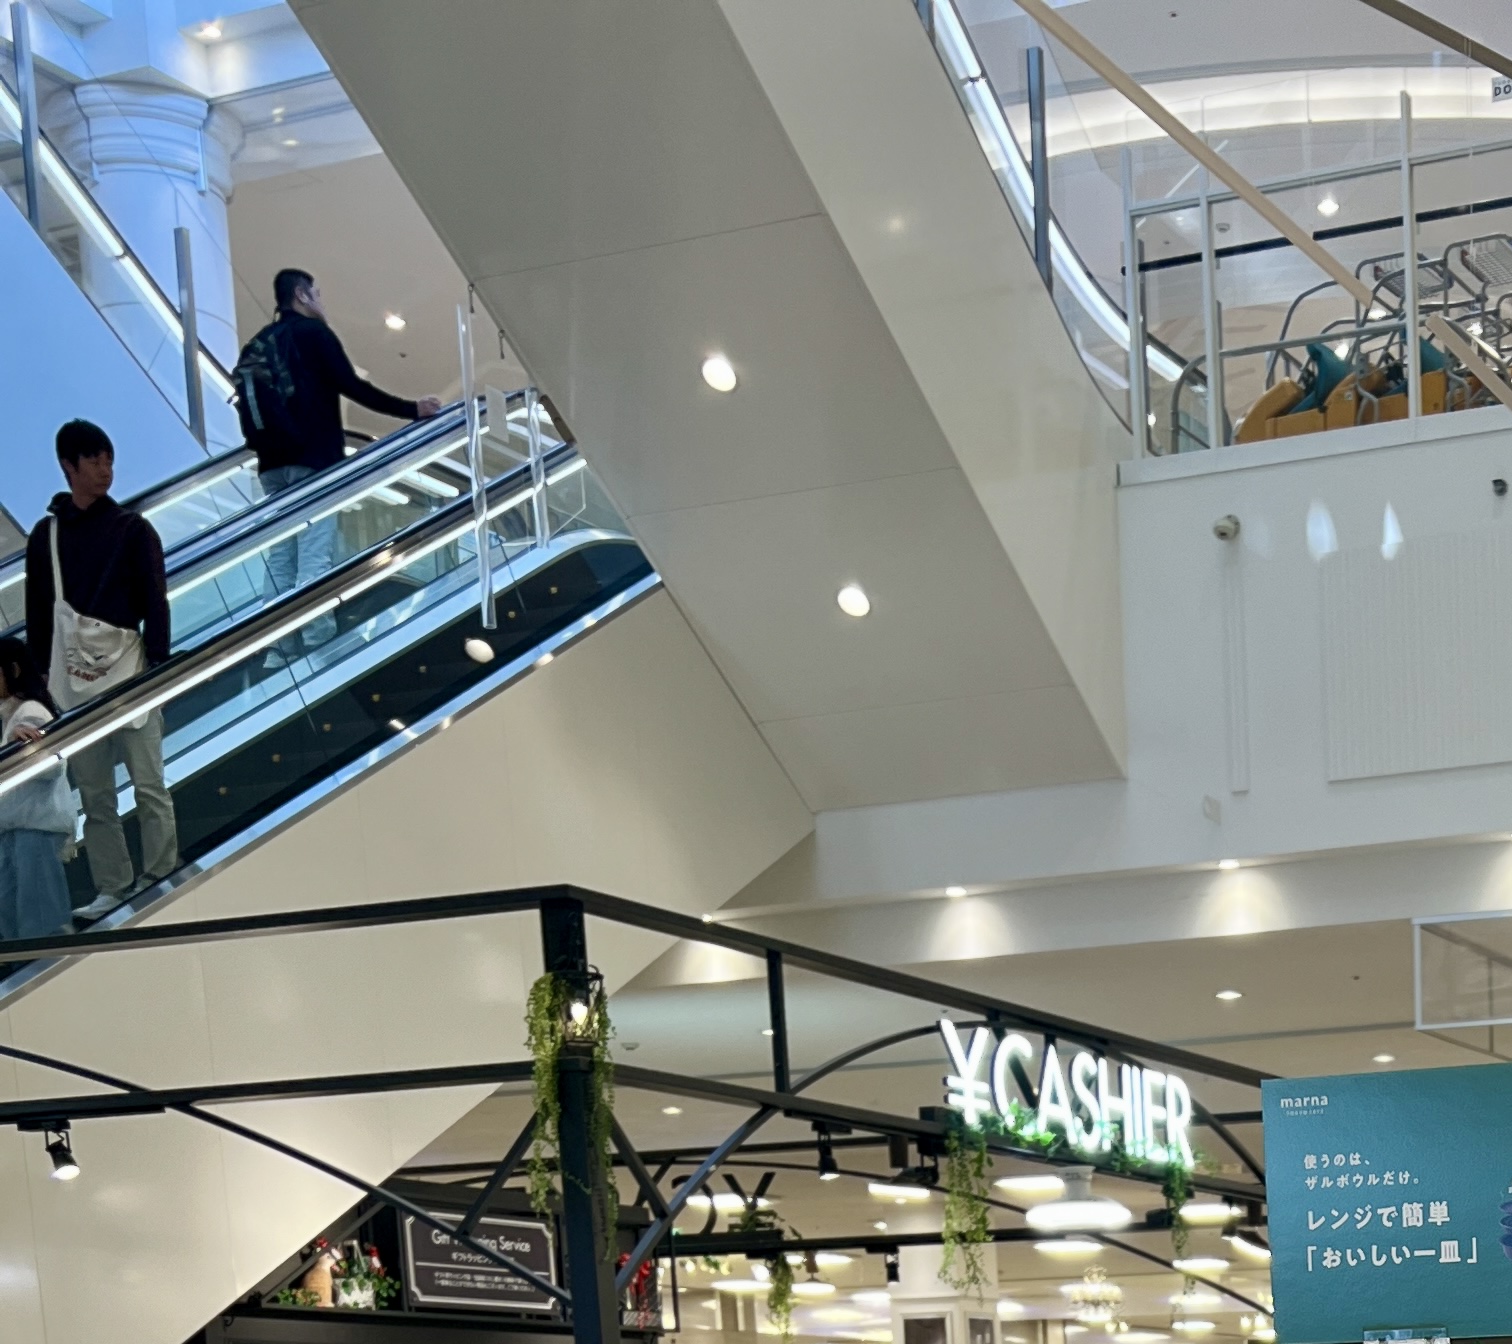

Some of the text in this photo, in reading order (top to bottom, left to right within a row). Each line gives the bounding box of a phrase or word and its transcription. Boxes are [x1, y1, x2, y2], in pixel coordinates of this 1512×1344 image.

[940, 1018, 1196, 1168] ¥CASHIER
[1280, 1095, 1329, 1108] marna
[1304, 1152, 1371, 1170] 使うのは、
[1304, 1170, 1420, 1191] ザルボウルだけ。
[1307, 1200, 1450, 1231] レンジで簡単
[1306, 1237, 1478, 1272] 「おいしい一皿」
